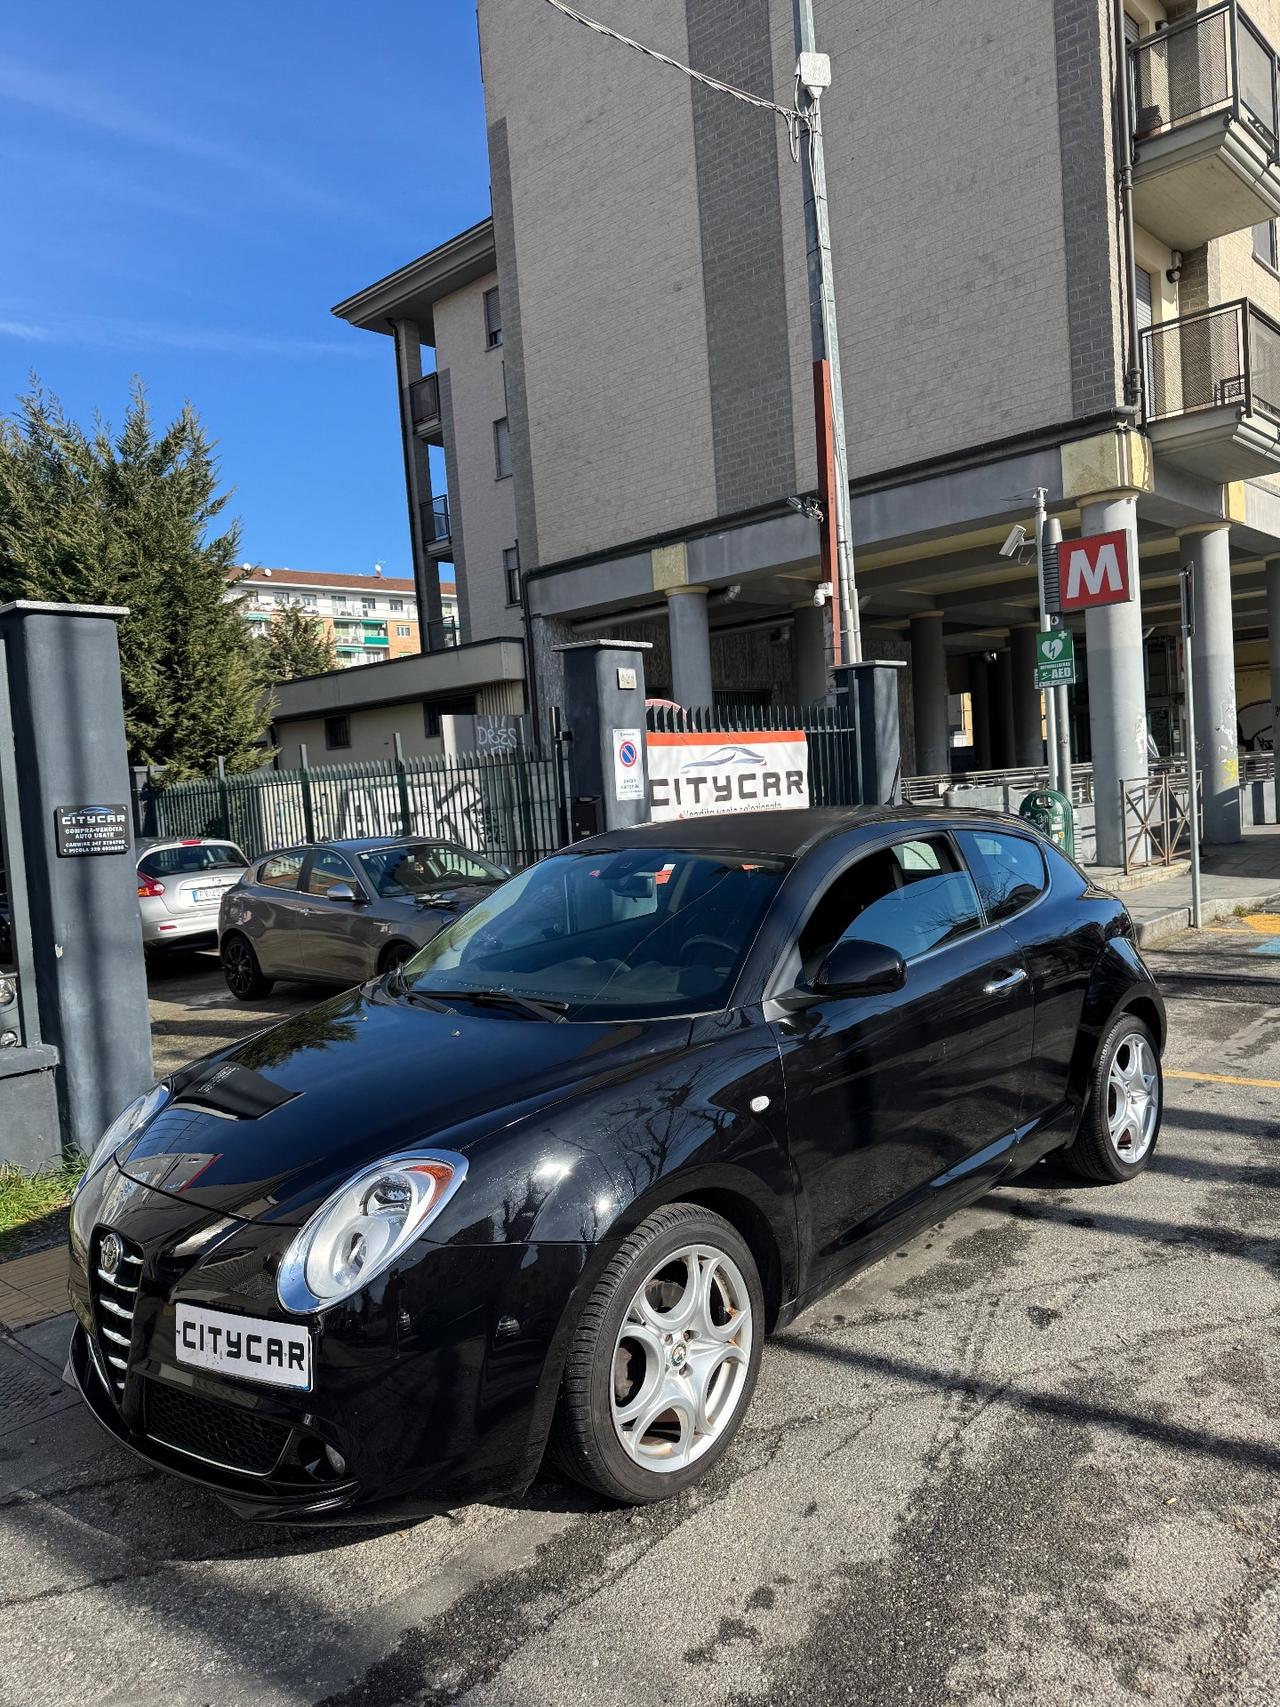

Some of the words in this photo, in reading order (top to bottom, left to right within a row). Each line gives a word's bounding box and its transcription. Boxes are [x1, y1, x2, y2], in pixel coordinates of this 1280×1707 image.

[1066, 543, 1124, 599] M
[1051, 667, 1072, 679] AED
[650, 770, 804, 808] CITYCAR
[62, 814, 126, 825] CITYCAR
[65, 826, 123, 835] COMPRA-VENDITA
[182, 1320, 305, 1371] CITYCAR
